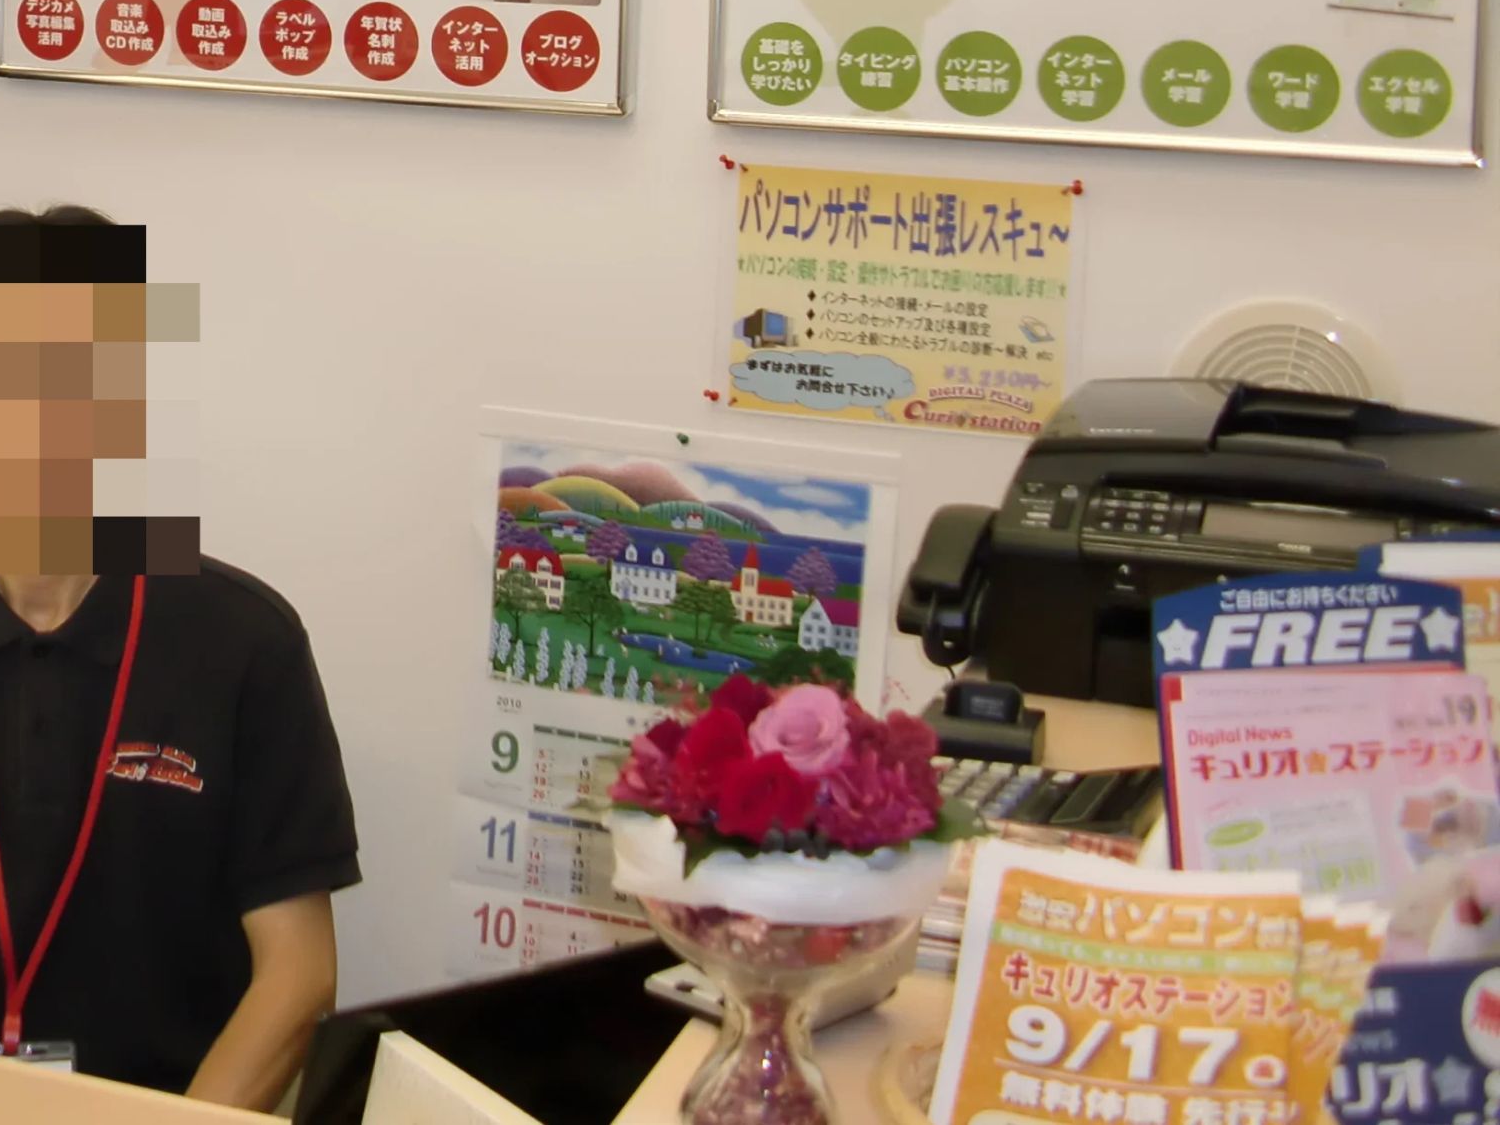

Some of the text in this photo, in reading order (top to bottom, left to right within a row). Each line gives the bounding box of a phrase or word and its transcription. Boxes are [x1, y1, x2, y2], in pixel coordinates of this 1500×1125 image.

[118, 3, 143, 17] 音楽
[199, 7, 225, 22] 動画
[26, 14, 75, 30] 写真編集
[110, 19, 149, 33] 取込み
[276, 11, 316, 27] ラベル
[361, 16, 402, 32] 年賀状
[192, 24, 232, 39] 取込み
[276, 28, 316, 43] ポップ
[442, 20, 498, 36] インター
[38, 30, 62, 46] 活用
[367, 33, 395, 50] 名刺
[449, 38, 490, 53] ネット
[539, 33, 582, 48] ブログ
[199, 41, 225, 56] 作成
[282, 45, 308, 60] 作成
[367, 50, 395, 67] 作成
[455, 54, 484, 70] 活用
[525, 50, 595, 69] オークション
[751, 57, 812, 73] しっかり
[839, 52, 917, 70] タイピング
[944, 57, 1011, 74] パソコン
[1046, 52, 1113, 69] インター
[751, 74, 812, 92] 学びたい
[1055, 71, 1104, 88] ネット
[1161, 67, 1211, 85] メール
[1269, 71, 1320, 89] ワード
[1370, 75, 1439, 94] エクセル
[1219, 583, 1399, 611] ご自由にお持ちください
[1201, 605, 1422, 670] FREE
[497, 696, 522, 711] 2010
[1245, 726, 1293, 743] News
[491, 731, 520, 773] 9
[480, 816, 517, 863] 11
[473, 901, 518, 950] 10
[1005, 1004, 1239, 1085] 9/17
